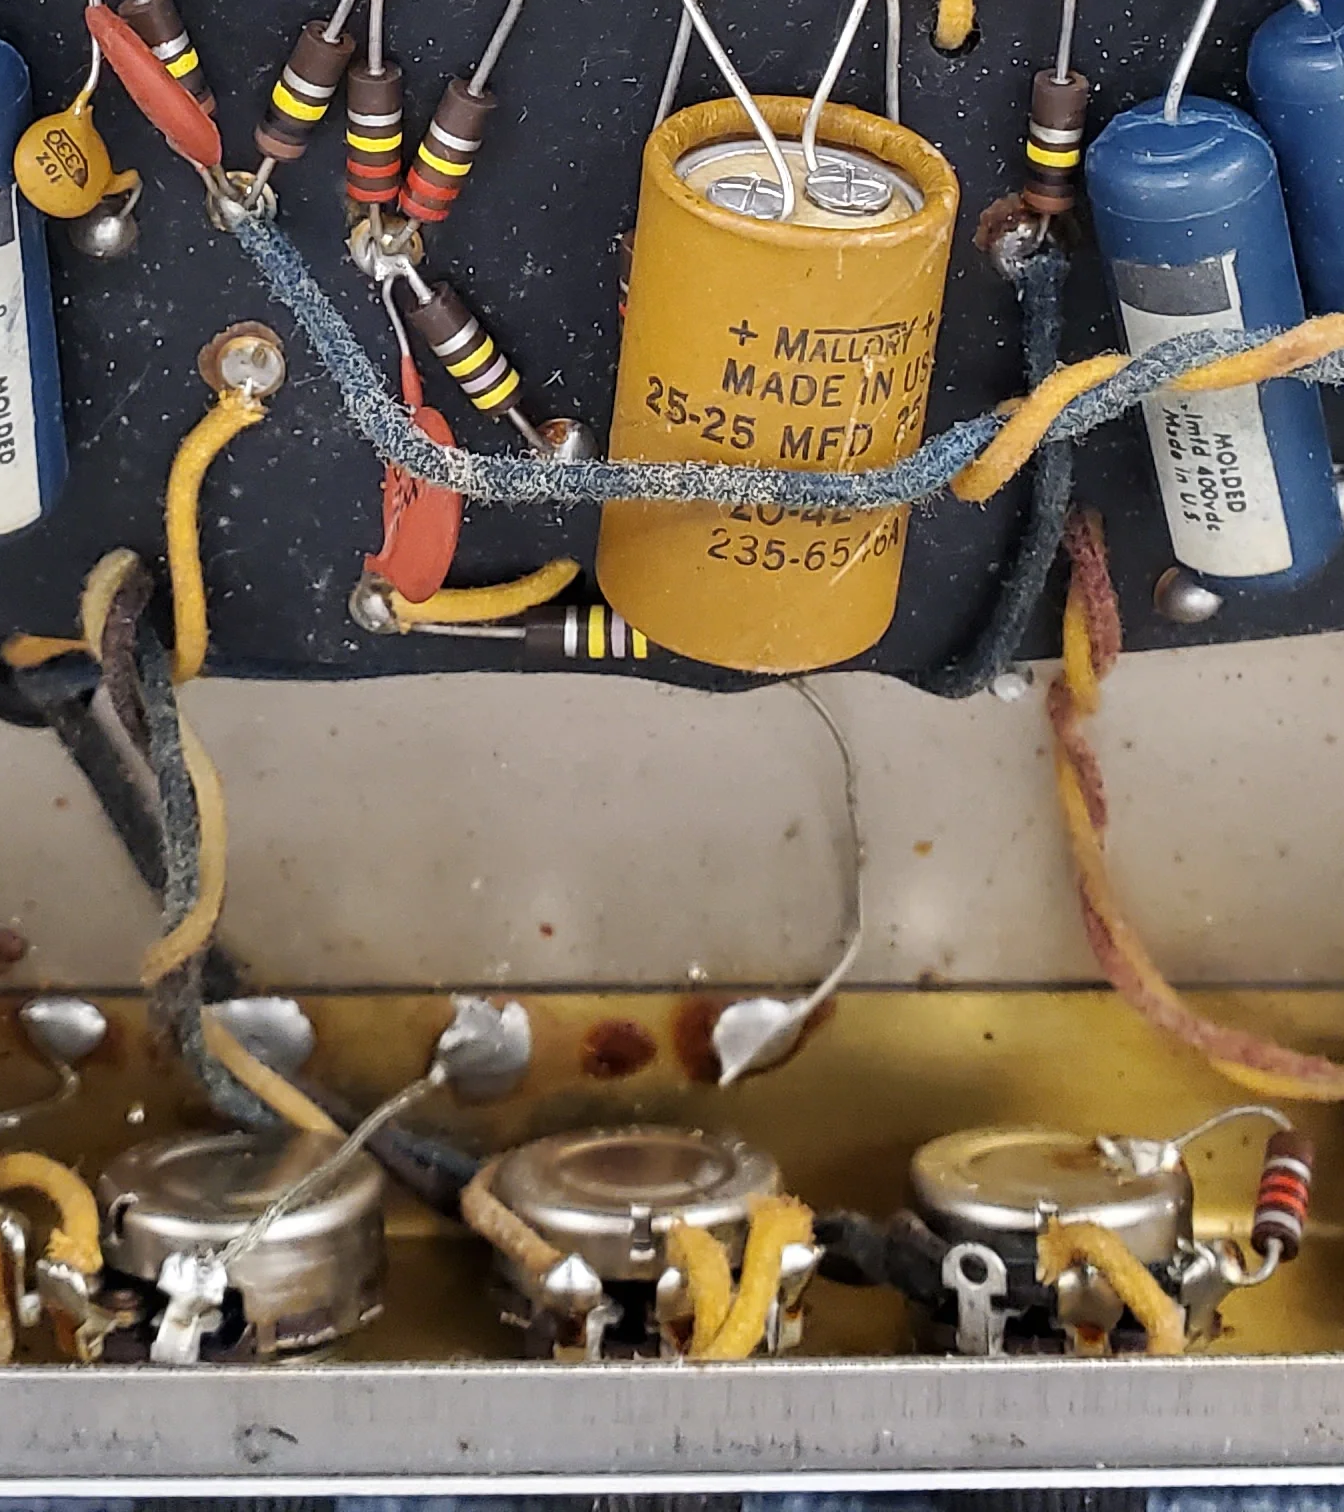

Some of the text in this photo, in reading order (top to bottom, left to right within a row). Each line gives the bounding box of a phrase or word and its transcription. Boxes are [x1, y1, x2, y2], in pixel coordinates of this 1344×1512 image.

[46, 129, 81, 169] 330
[721, 357, 846, 408] MADE
[859, 367, 895, 406] IN
[645, 375, 758, 451] 25-25
[779, 422, 874, 462] MFD
[1162, 407, 1187, 462] Made
[1196, 464, 1225, 532] 400vdc
[1212, 432, 1248, 514] MOLDED
